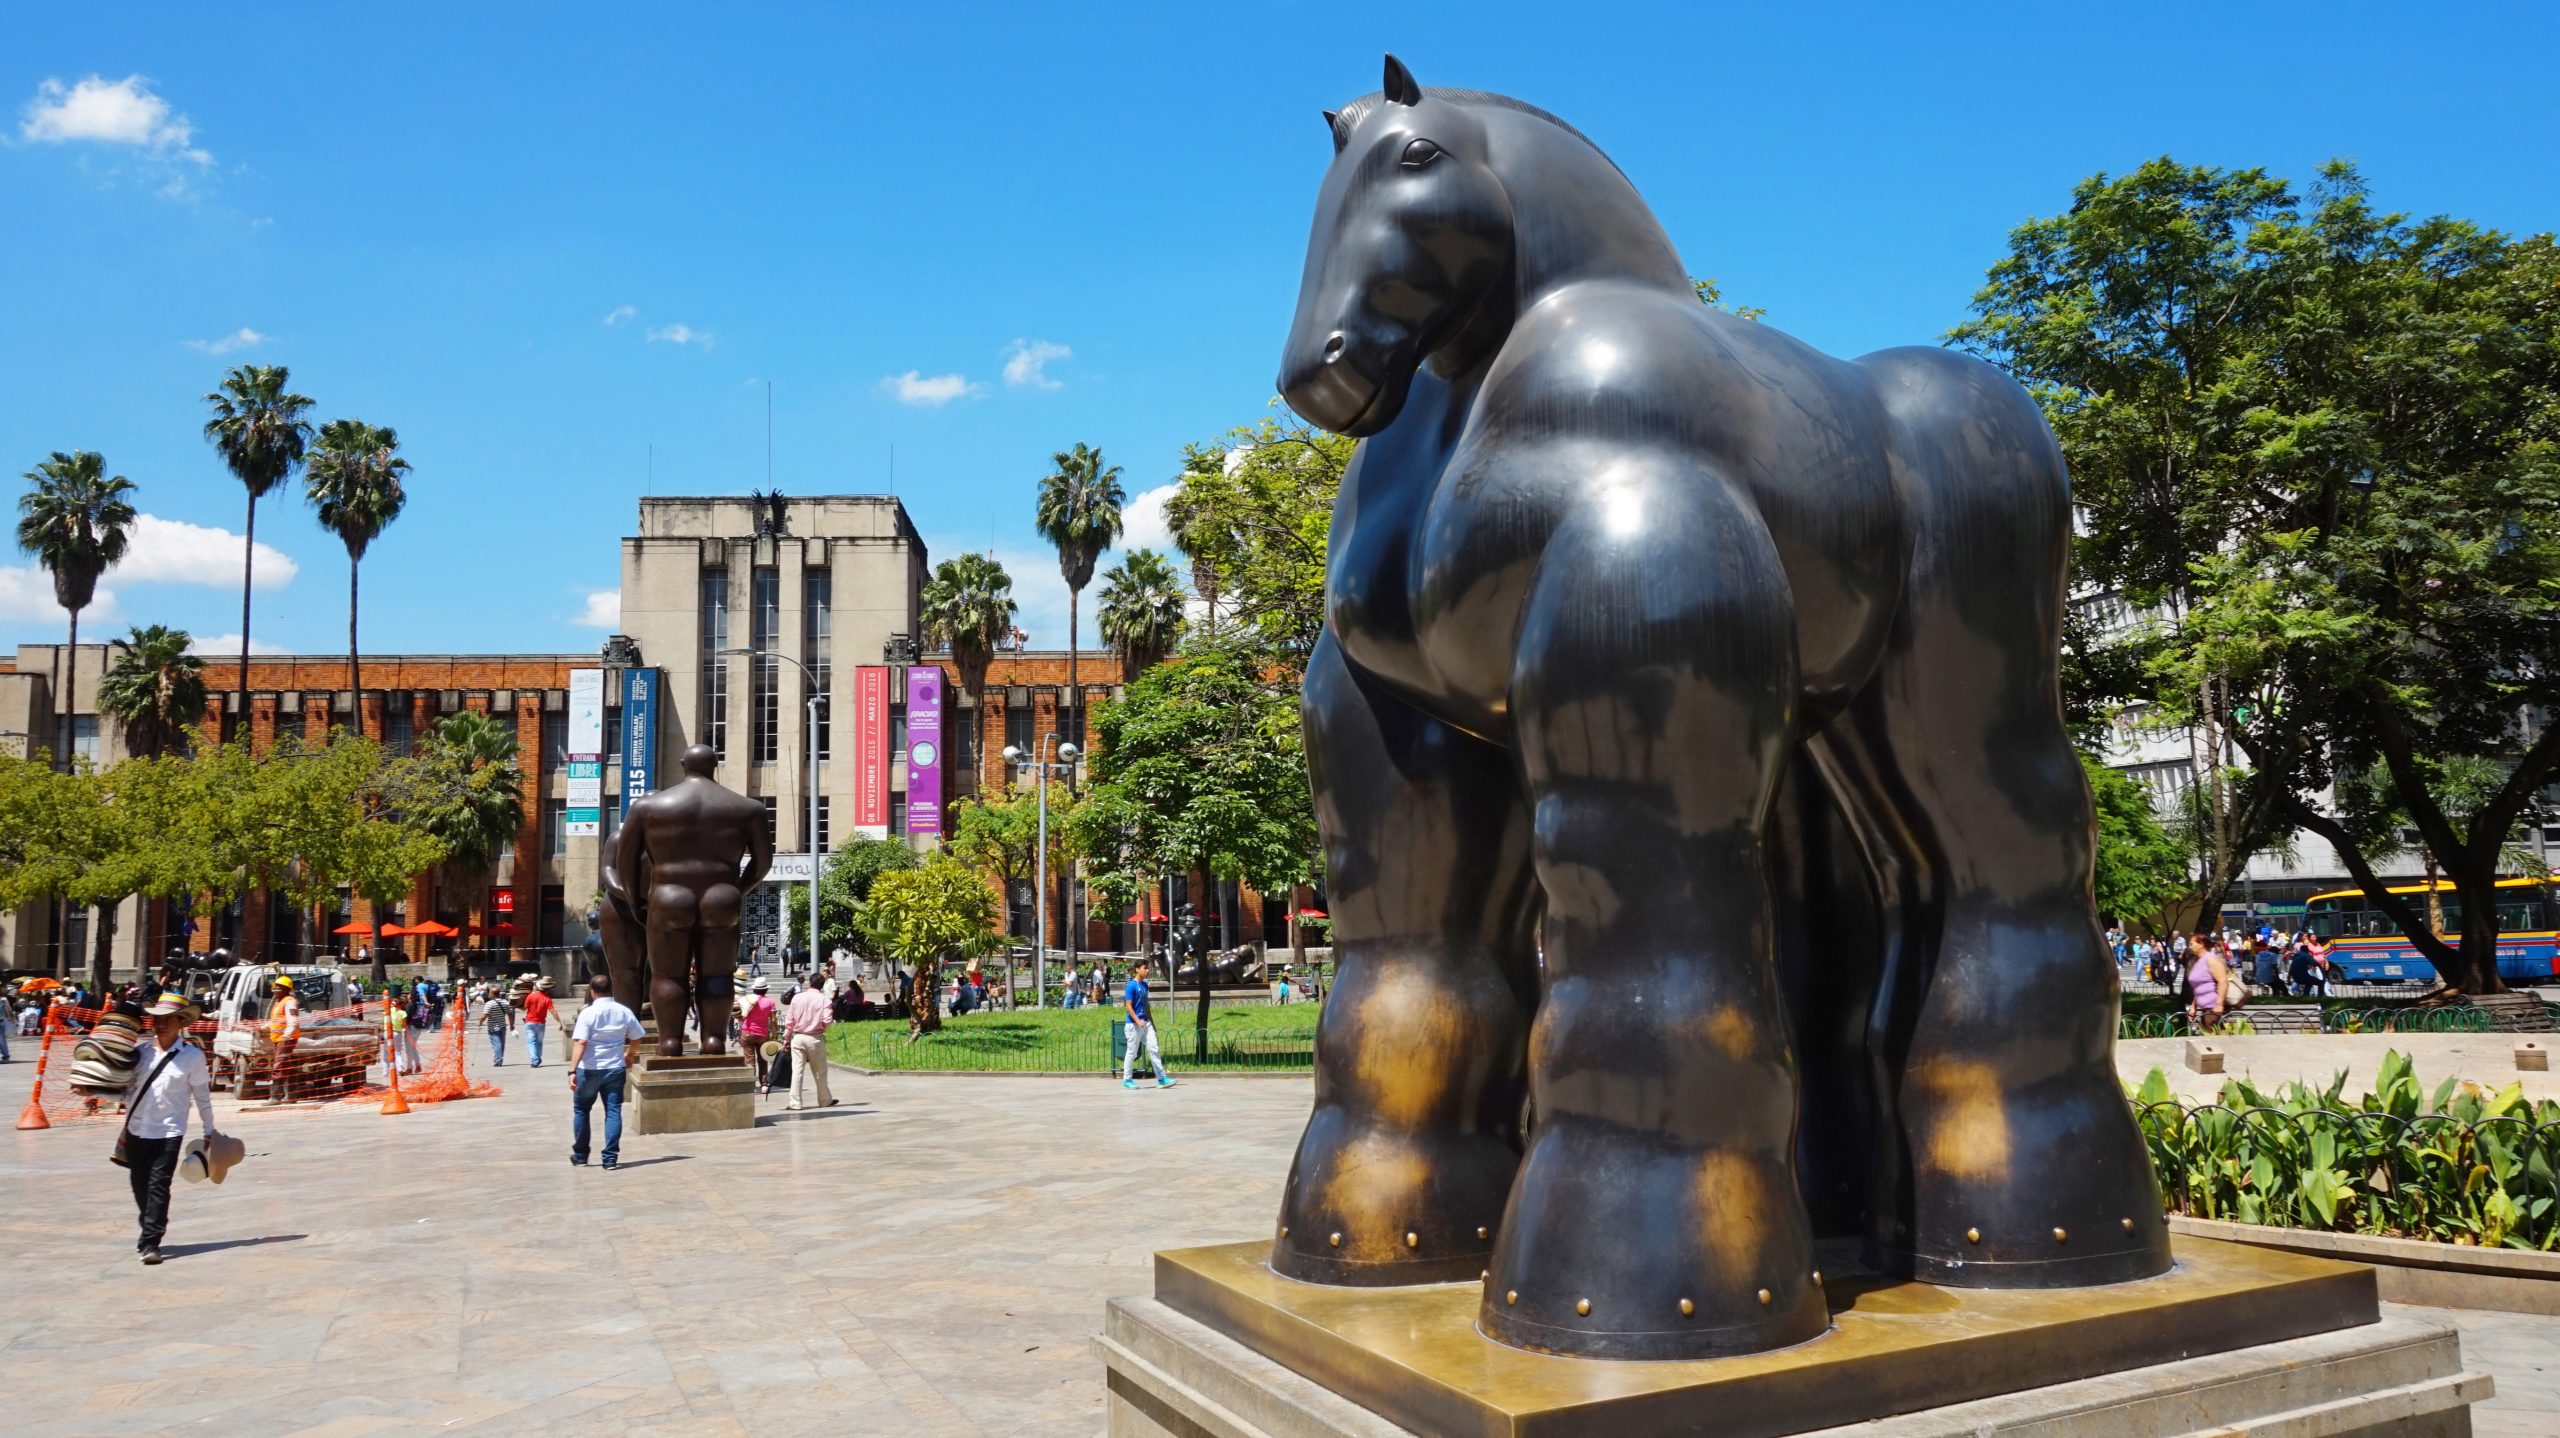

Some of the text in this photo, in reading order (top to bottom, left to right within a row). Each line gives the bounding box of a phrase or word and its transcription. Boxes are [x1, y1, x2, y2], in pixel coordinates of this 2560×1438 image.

[868, 672, 876, 692] 2016
[868, 696, 876, 721] MARZO
[572, 754, 597, 762] ENTRADA
[868, 740, 876, 760] 2015
[570, 763, 599, 777] LIBRE
[867, 764, 876, 808] NOVIEMBRE
